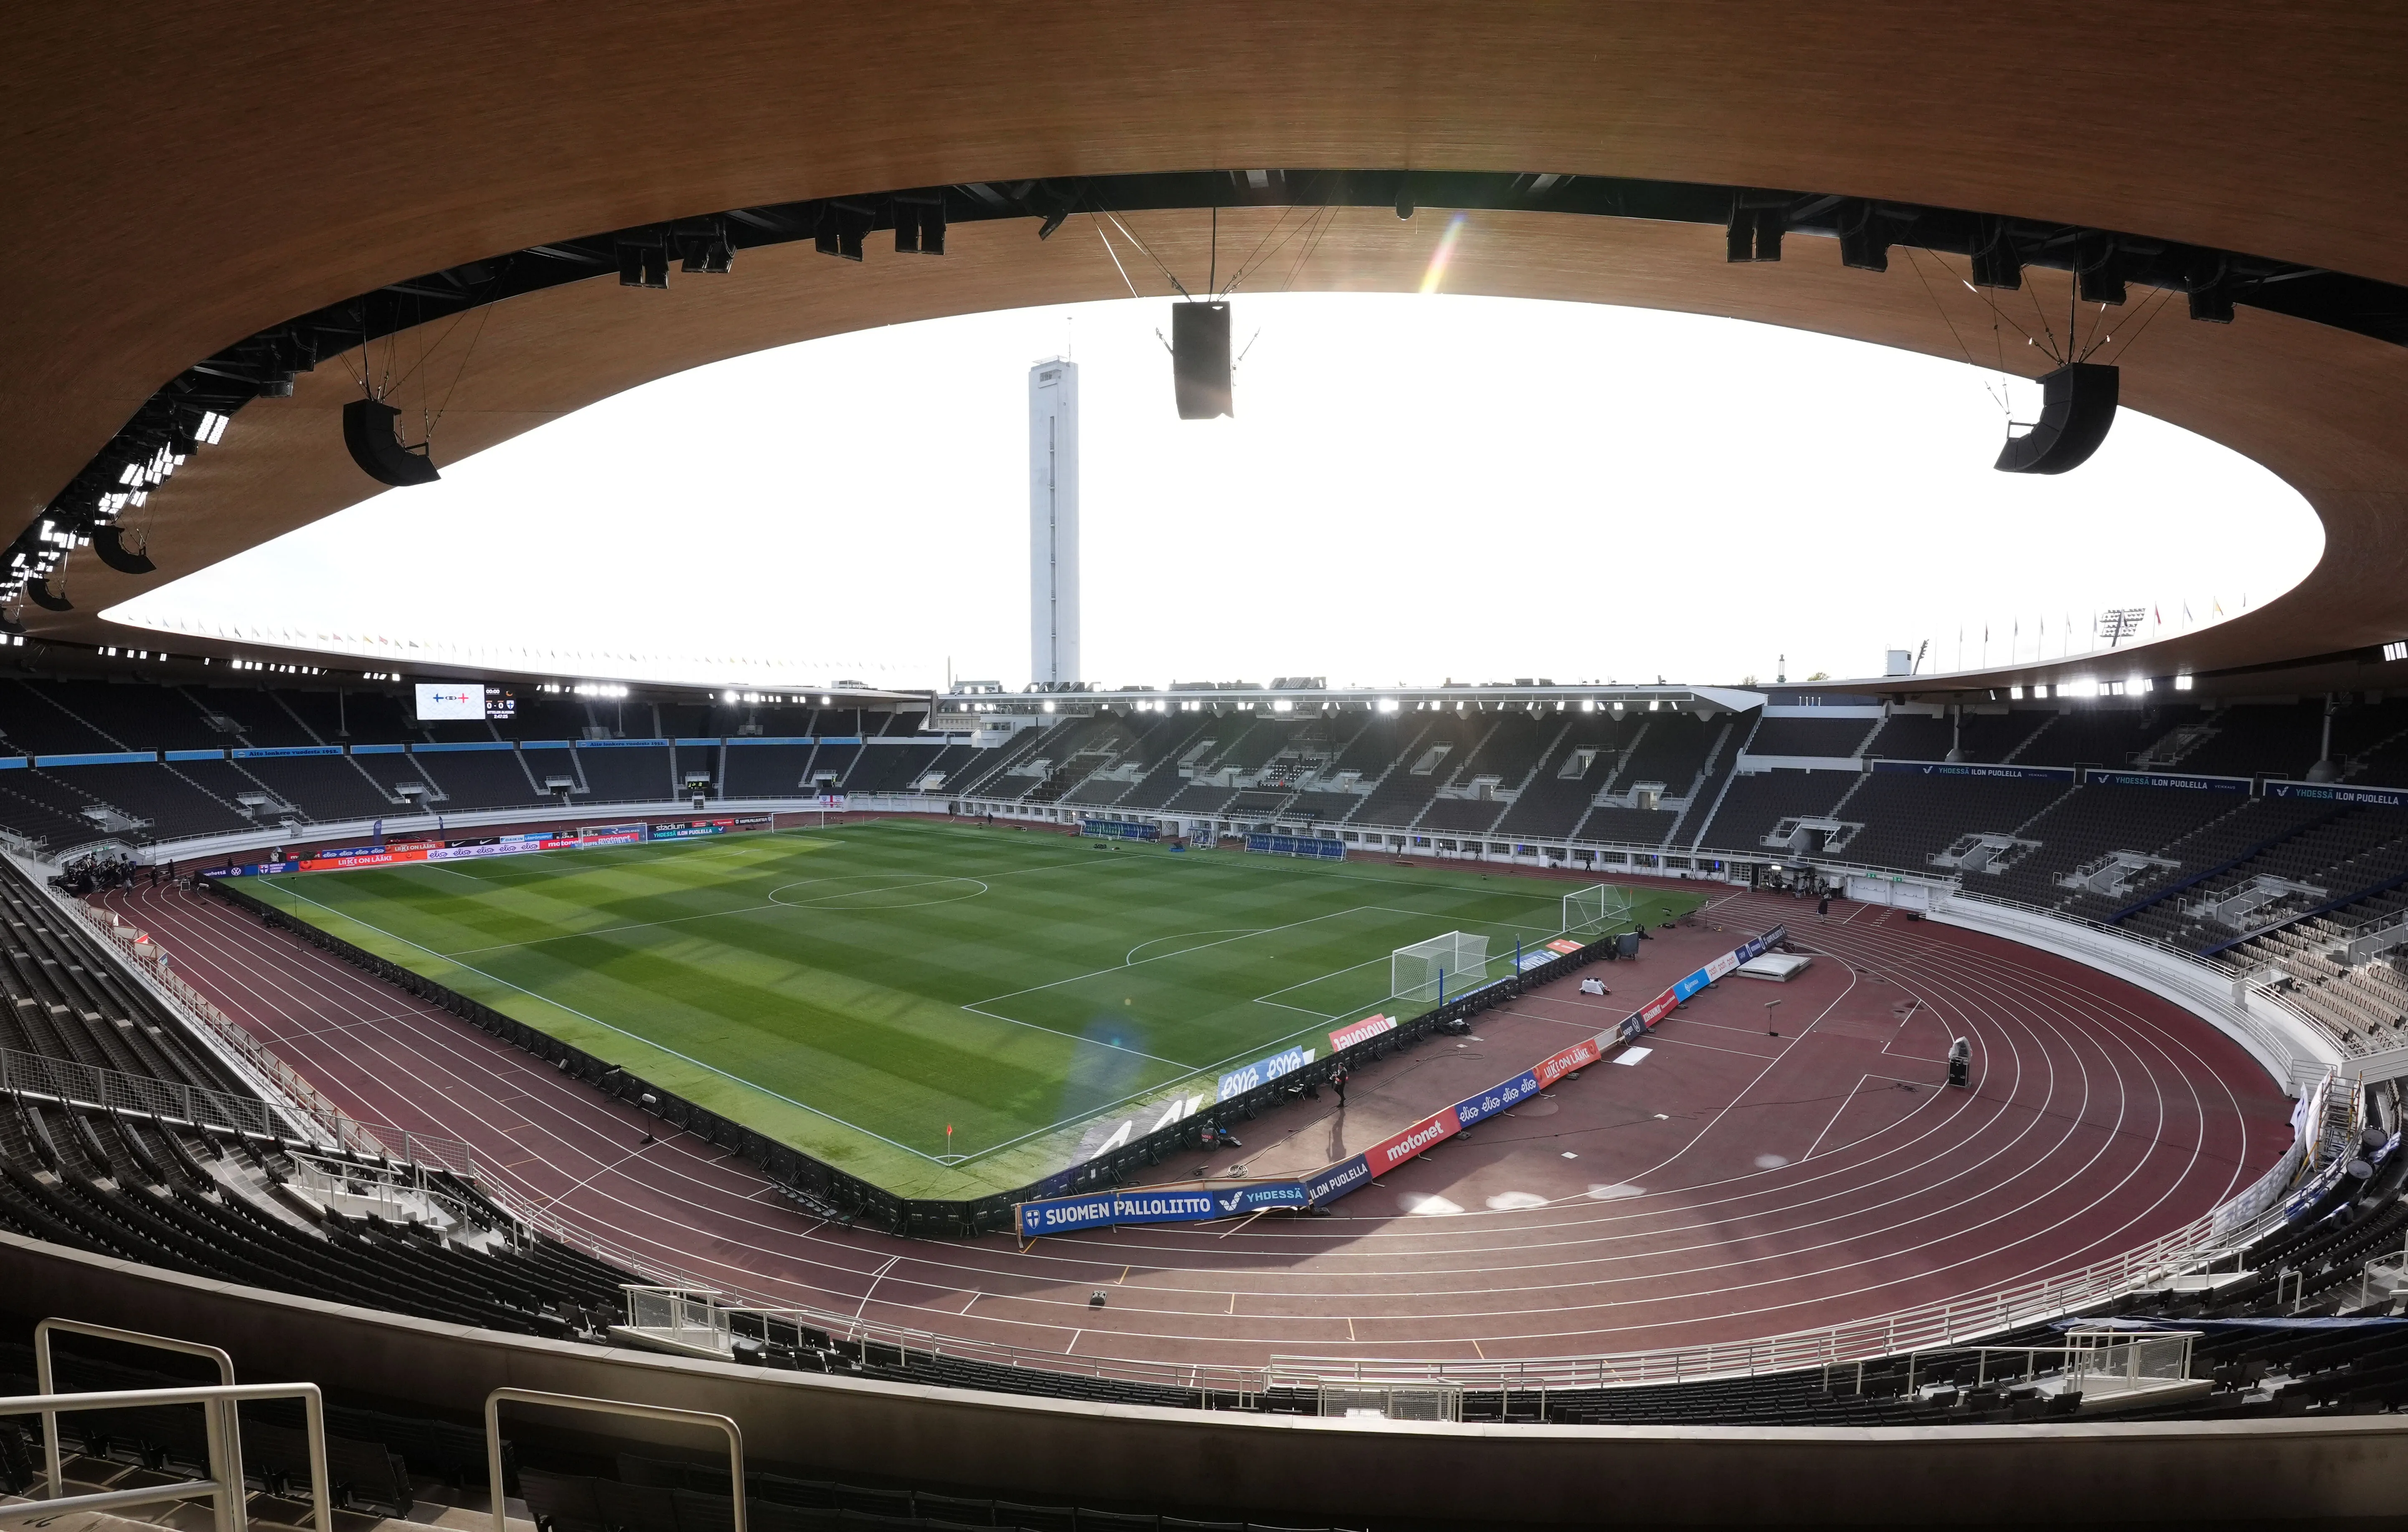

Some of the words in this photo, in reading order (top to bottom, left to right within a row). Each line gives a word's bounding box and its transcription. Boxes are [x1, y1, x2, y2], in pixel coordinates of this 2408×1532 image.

[2115, 776, 2149, 785] YHDESSÄ
[2170, 780, 2208, 789] PUOLELLA
[2296, 789, 2333, 799] YHDESSÄ
[2336, 791, 2354, 801] ILON
[2357, 794, 2399, 805] PUOLELLA
[338, 857, 358, 866] LIIKE
[1544, 1060, 1560, 1078] LIIKE
[1559, 1056, 1572, 1069] ON
[1570, 1048, 1590, 1064] LÄÄKE
[1459, 1106, 1479, 1122] elisa
[1482, 1096, 1500, 1112] elisa
[1502, 1088, 1519, 1103] elisa
[1520, 1078, 1537, 1093] elisa
[1386, 1120, 1444, 1161] motonet
[1246, 1187, 1303, 1202] YHDESSÄ
[1309, 1182, 1330, 1200] ILON
[1330, 1163, 1368, 1190] PUOLELLA
[1046, 1202, 1110, 1225] SUOMEN
[1113, 1198, 1210, 1216] PALLOLIITTO
